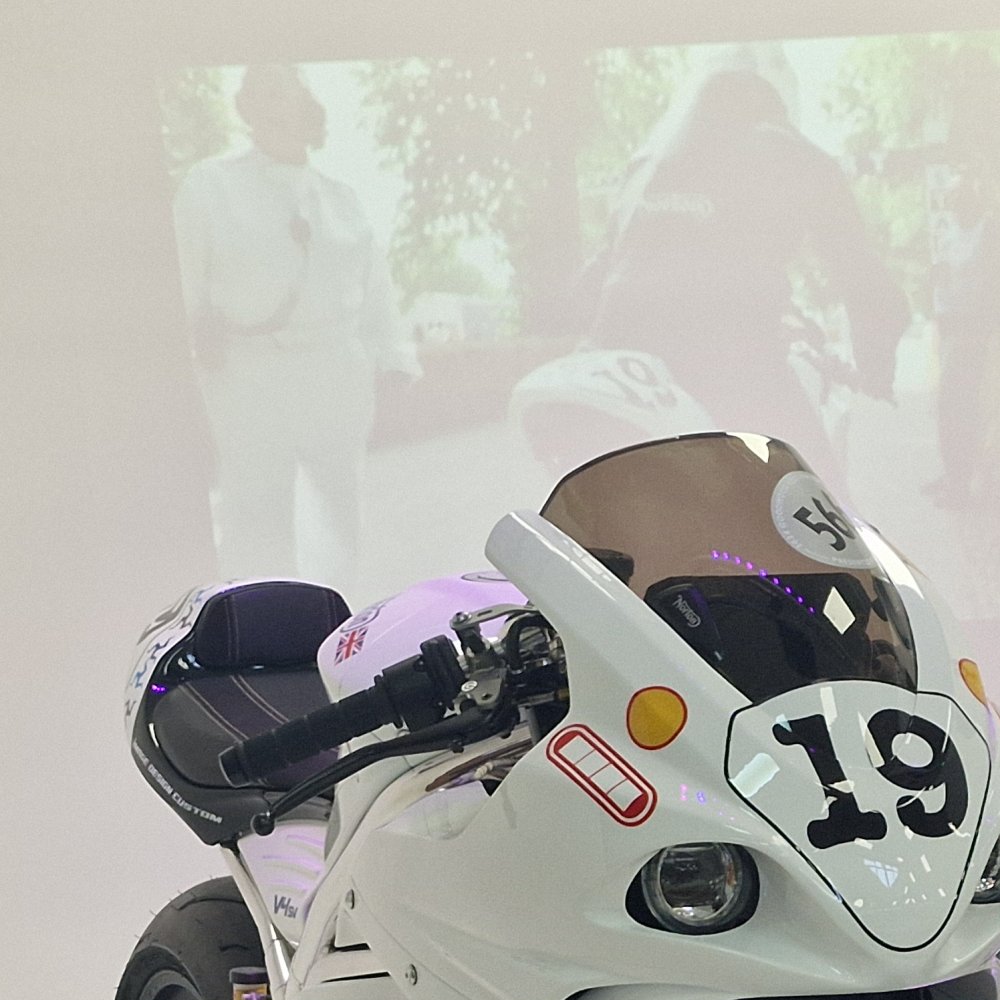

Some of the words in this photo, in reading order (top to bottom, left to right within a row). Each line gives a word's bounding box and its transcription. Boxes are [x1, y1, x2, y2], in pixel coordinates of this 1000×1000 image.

[793, 489, 857, 552] 56
[147, 763, 174, 795] DESIGN
[172, 792, 223, 824] CUSTOM
[772, 709, 969, 849] 19
